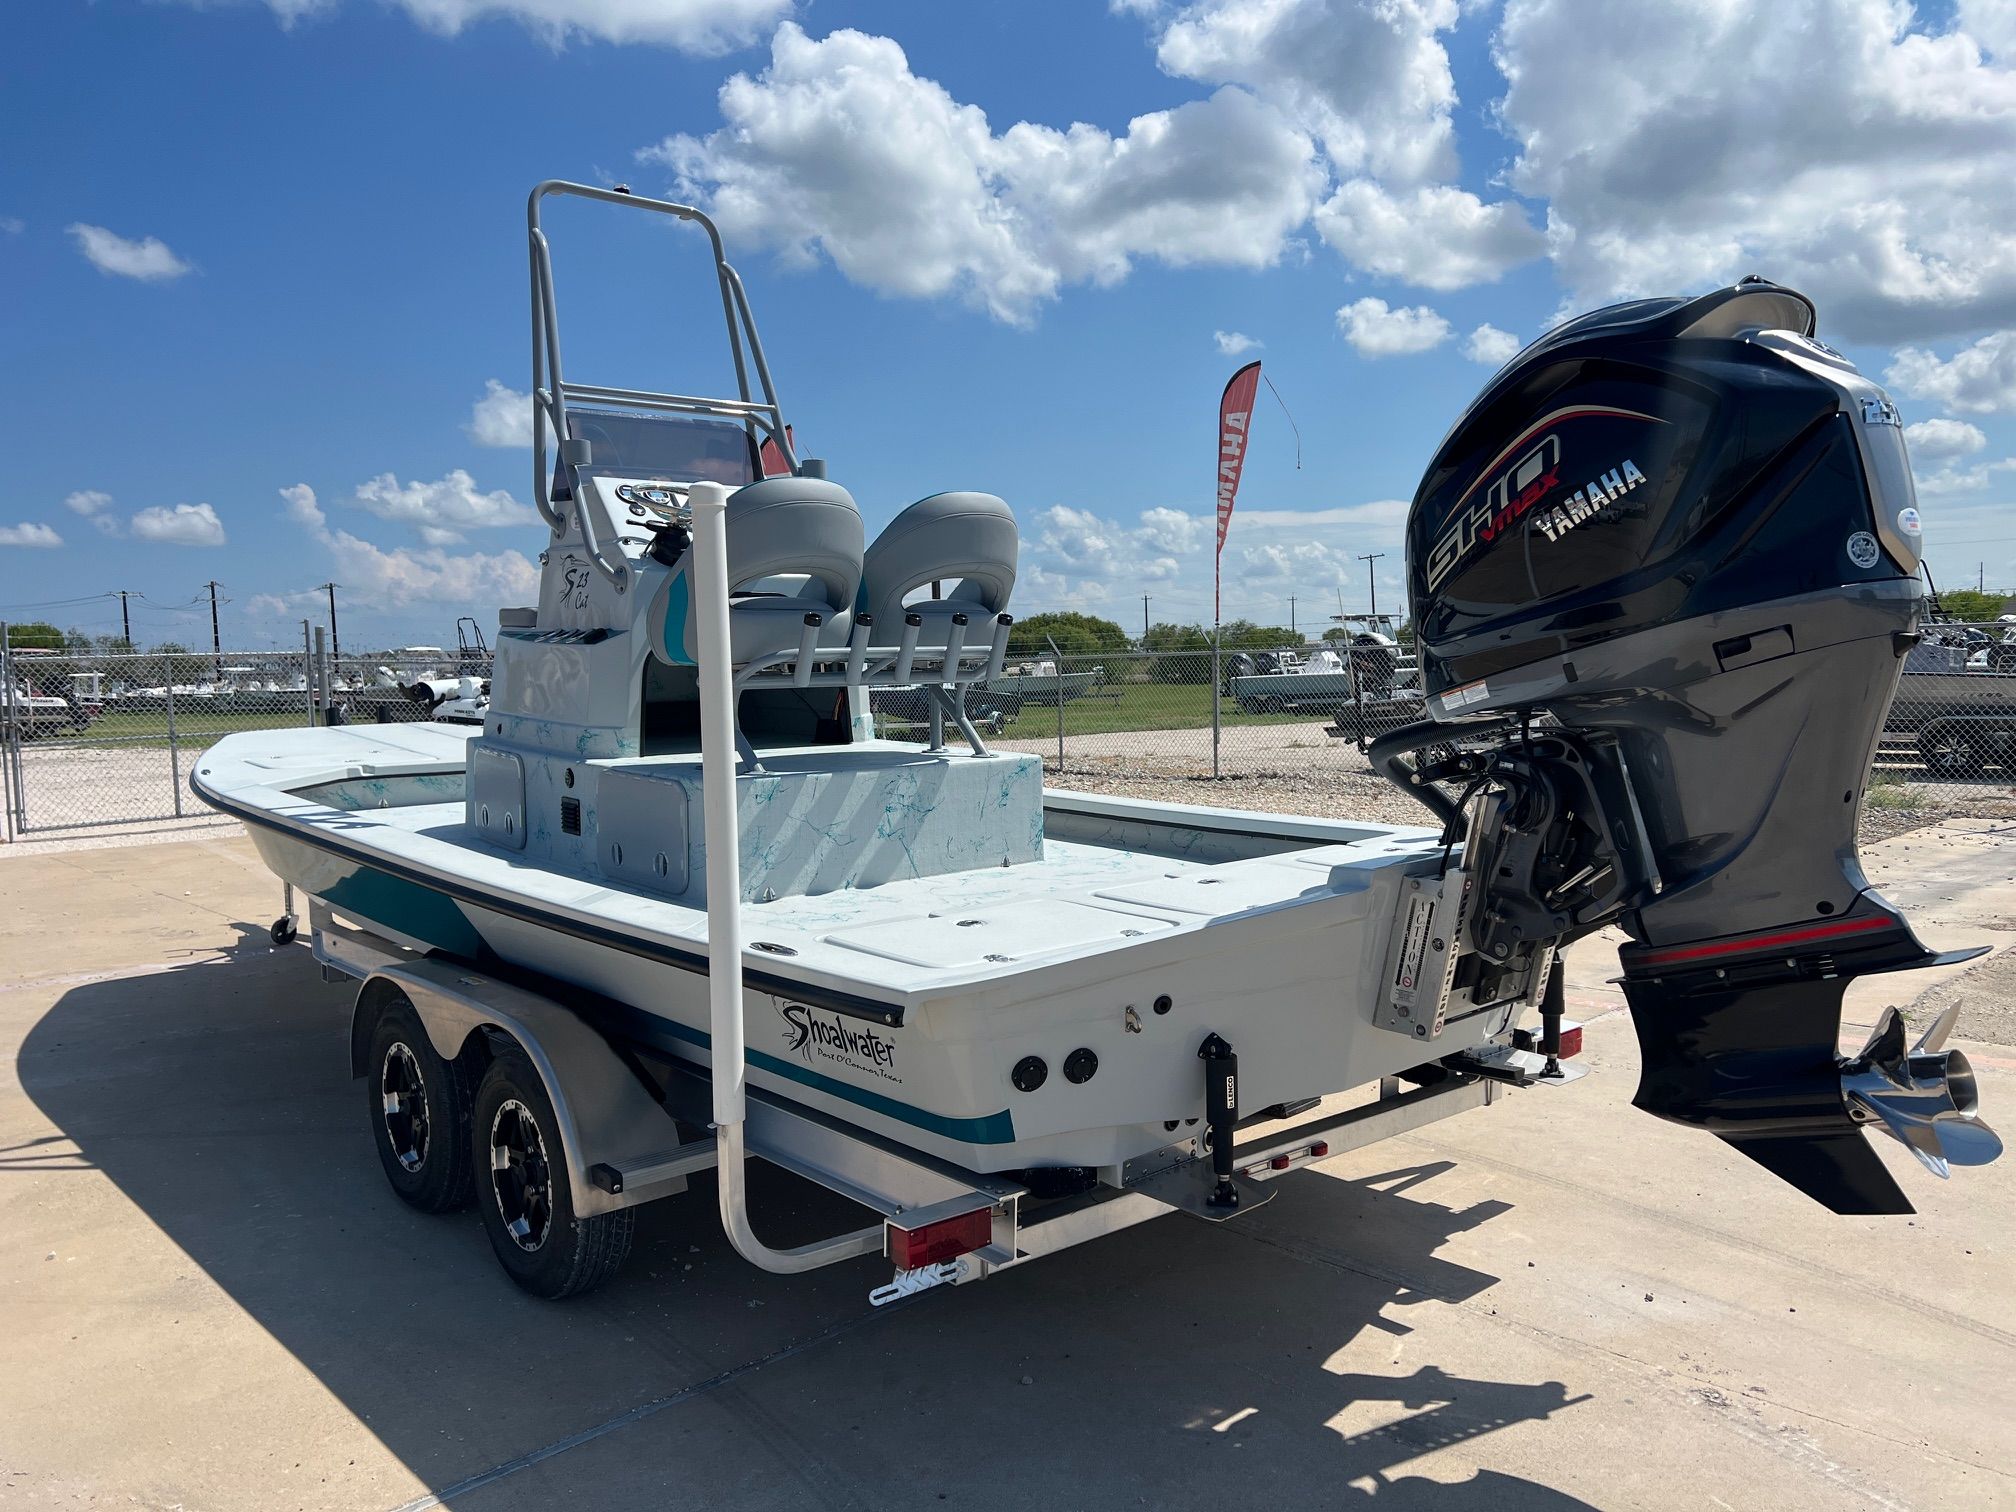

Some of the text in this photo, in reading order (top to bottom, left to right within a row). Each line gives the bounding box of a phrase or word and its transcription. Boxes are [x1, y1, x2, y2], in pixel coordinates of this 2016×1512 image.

[1535, 458, 1647, 543] YAMAHA
[575, 591, 590, 610] Cat
[576, 571, 590, 589] 23
[1404, 901, 1425, 976] ACTION
[782, 1005, 895, 1068] Shoalwater
[817, 1047, 835, 1060] Port
[879, 1068, 903, 1084] Texas
